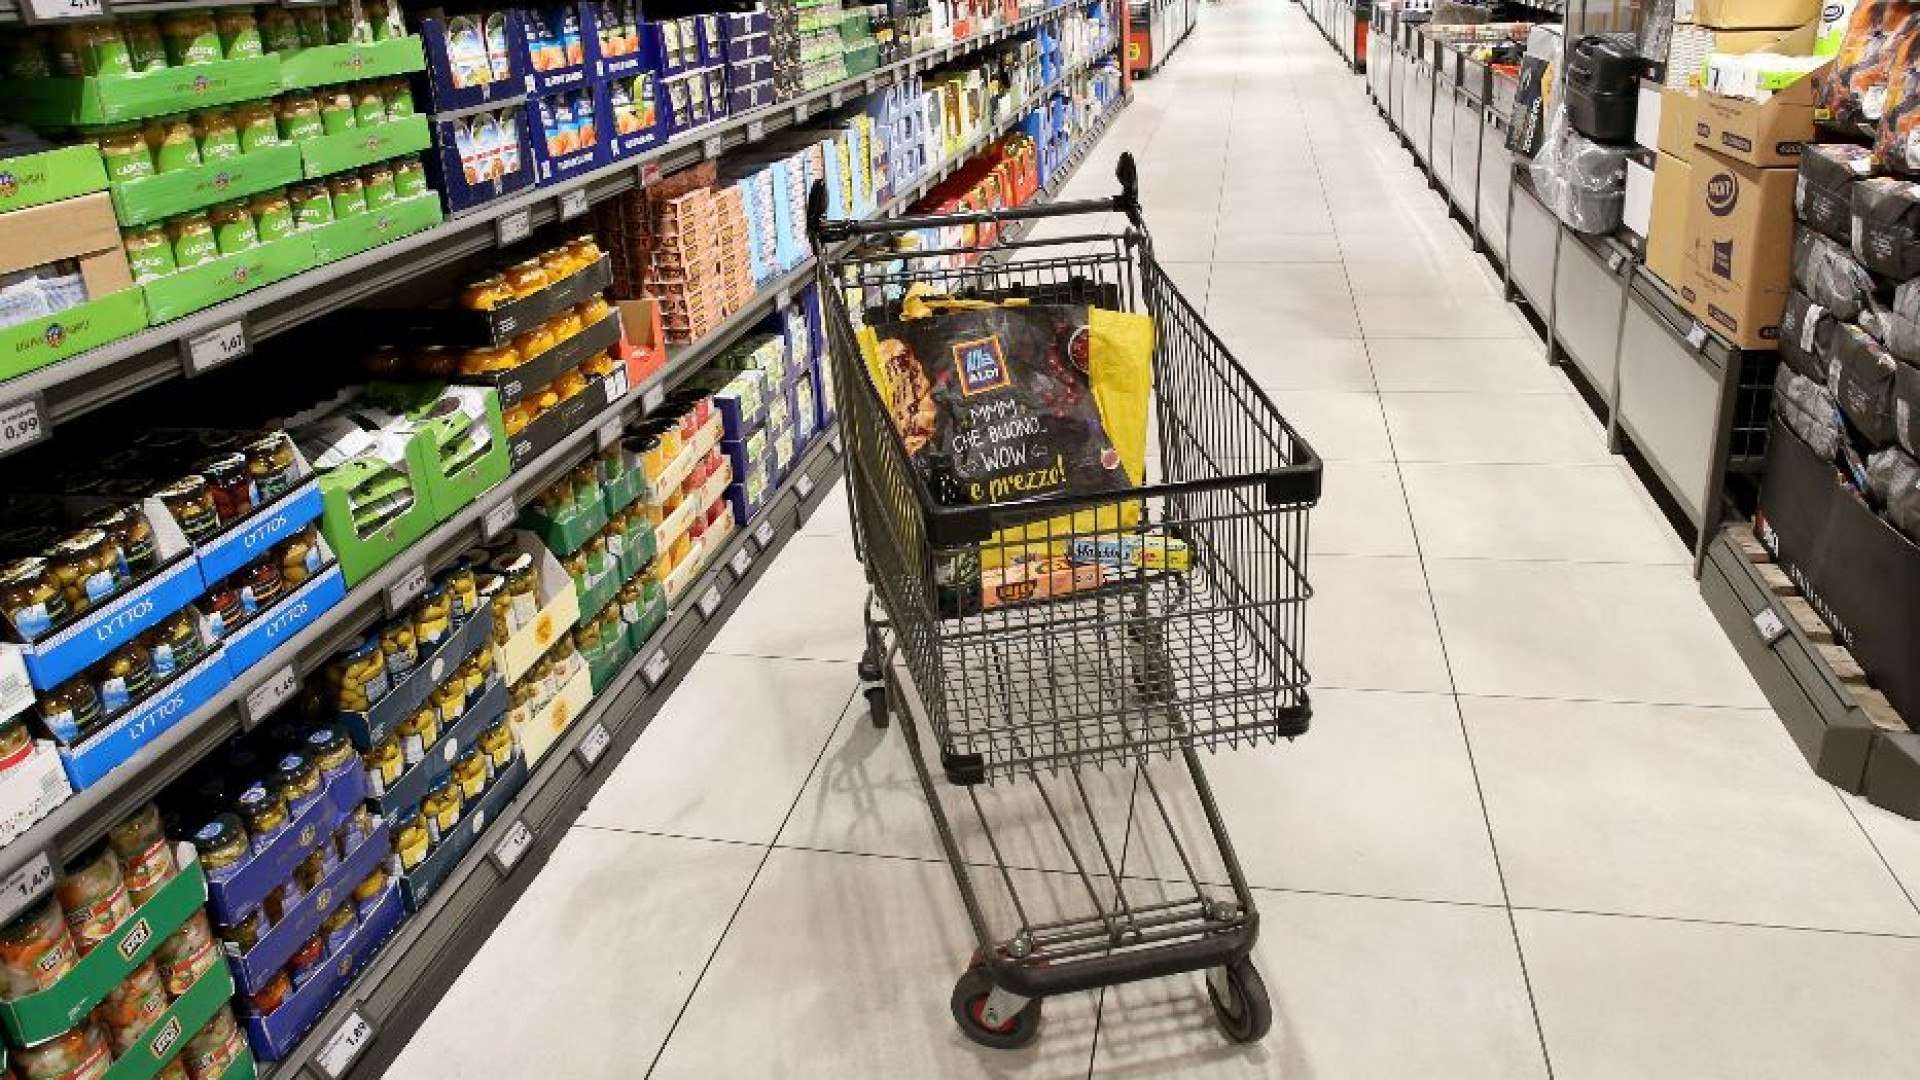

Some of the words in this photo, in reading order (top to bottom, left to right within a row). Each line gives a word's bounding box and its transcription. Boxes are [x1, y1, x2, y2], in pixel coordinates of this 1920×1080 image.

[968, 367, 999, 384] ALDI
[952, 429, 985, 454] CHE
[979, 442, 1027, 472] WOW
[988, 453, 1068, 503] prezzo!
[244, 514, 288, 548] LYTTOS
[97, 599, 154, 641] LYTTOS
[265, 601, 310, 638] LYTTOS
[128, 695, 185, 740] LYTTOS
